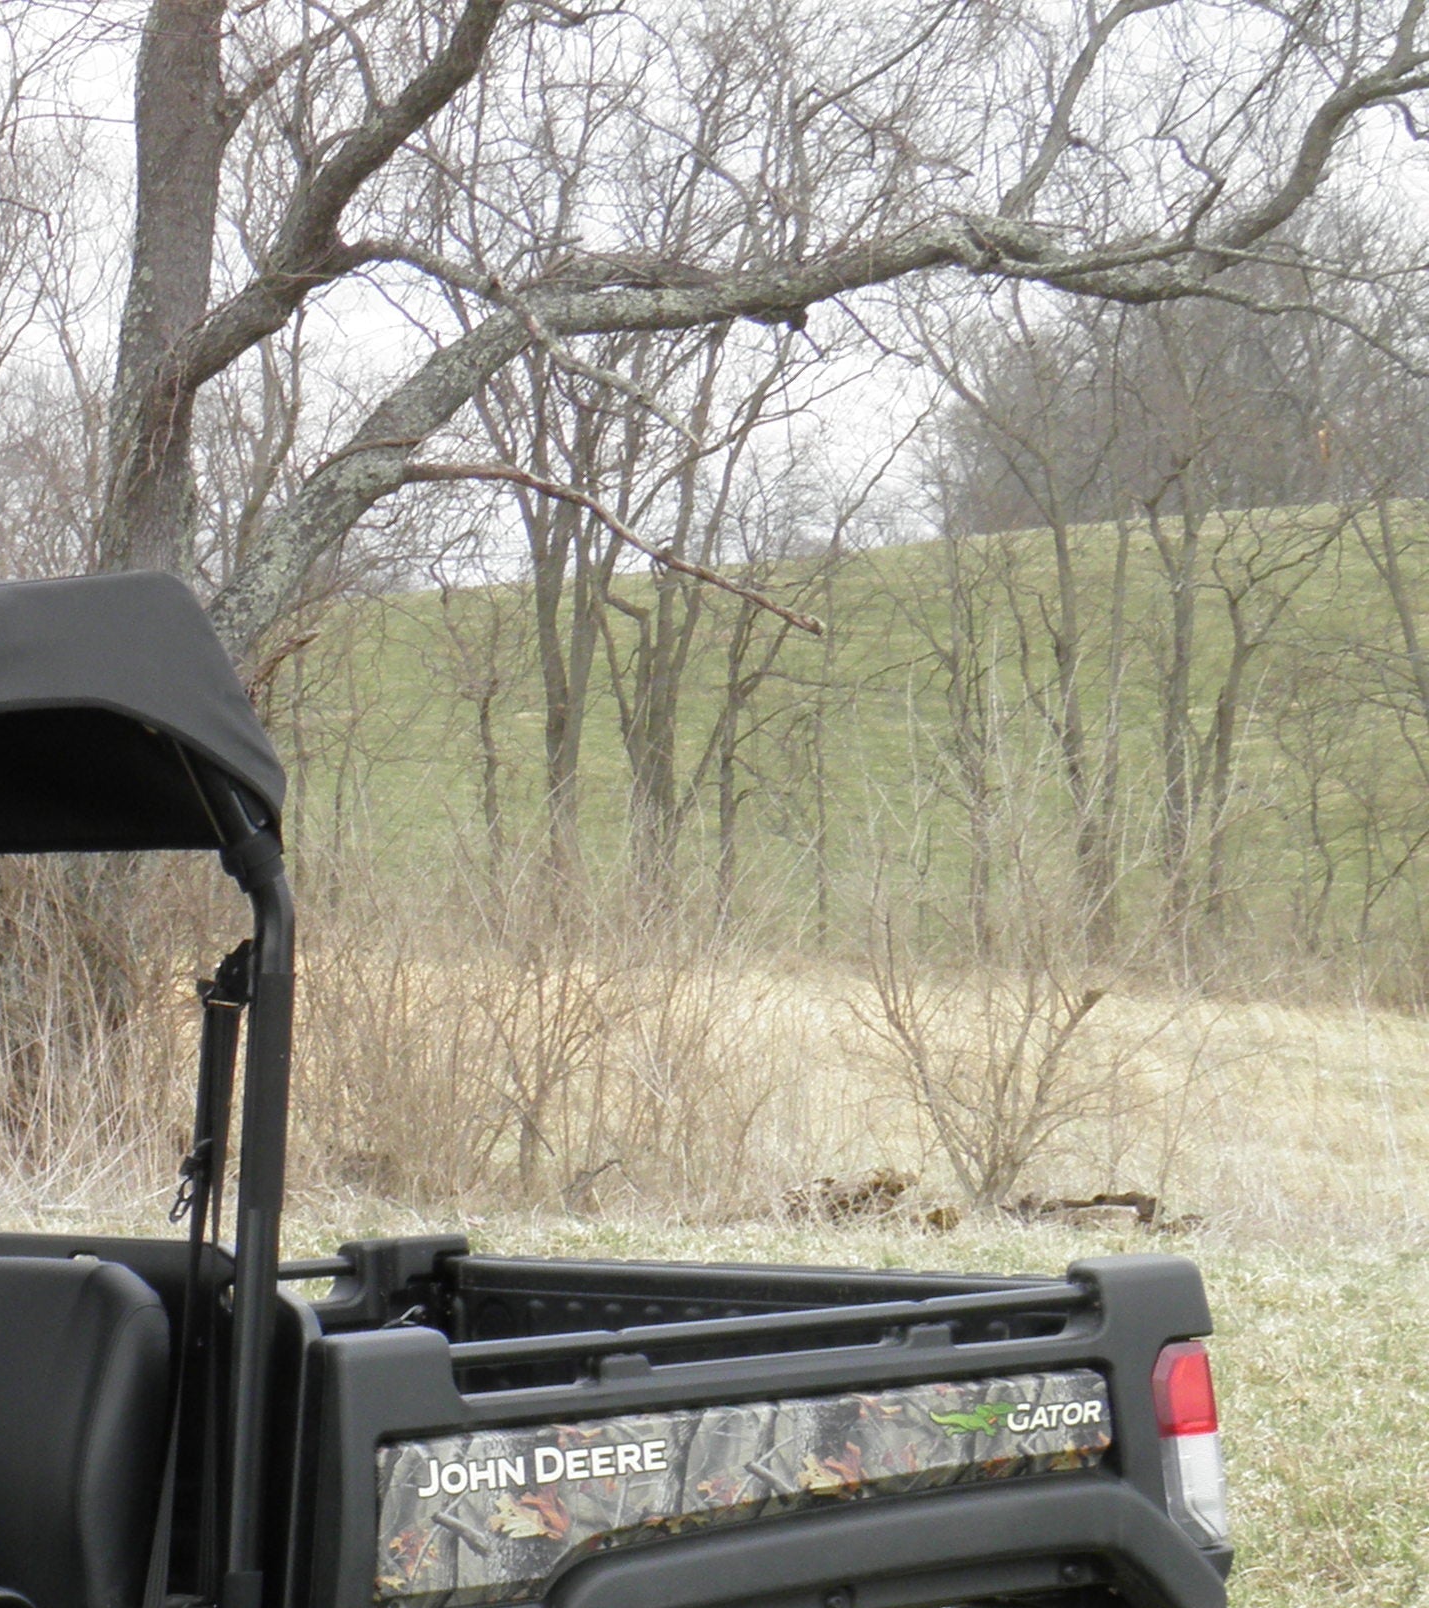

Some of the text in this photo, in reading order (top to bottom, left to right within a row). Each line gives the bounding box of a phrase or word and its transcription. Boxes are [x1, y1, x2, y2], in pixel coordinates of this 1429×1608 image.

[1007, 1400, 1102, 1432] GATOR
[418, 1440, 668, 1498] JOHN DEERE
